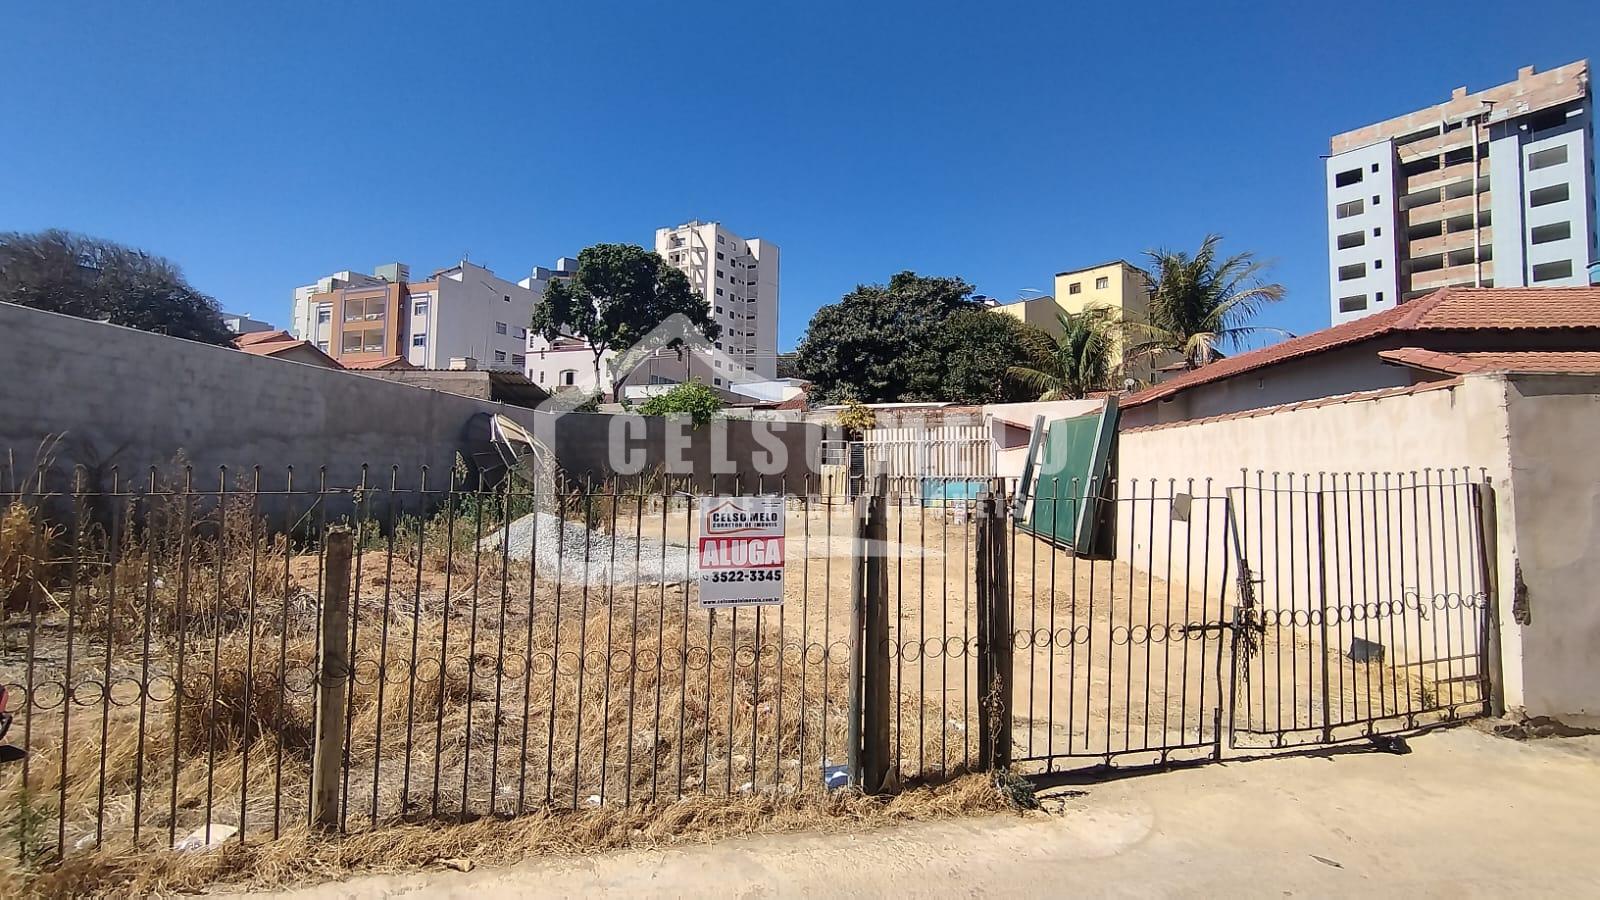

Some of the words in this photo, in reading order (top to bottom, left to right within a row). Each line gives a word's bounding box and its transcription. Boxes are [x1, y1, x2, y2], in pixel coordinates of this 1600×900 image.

[713, 513, 746, 522] CELSO
[750, 512, 778, 521] MELO
[702, 539, 780, 566] ALUGA
[712, 570, 781, 582] 3522-3345
